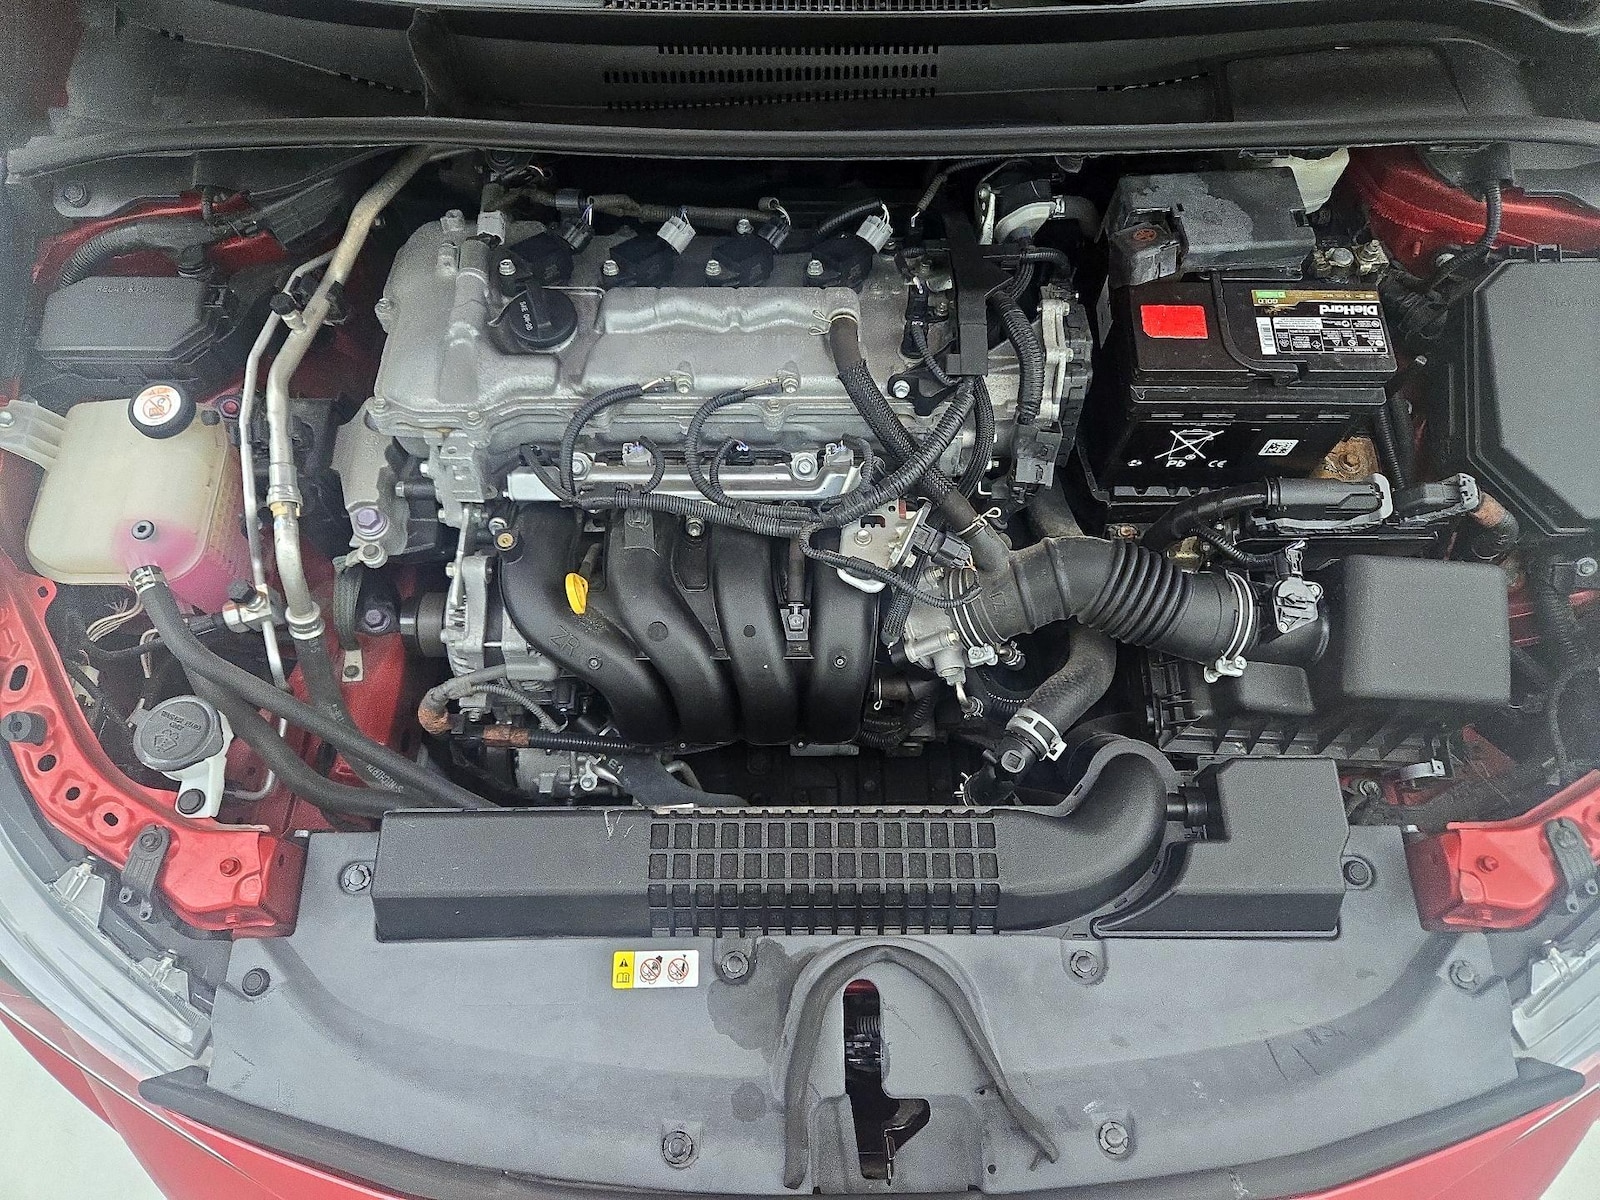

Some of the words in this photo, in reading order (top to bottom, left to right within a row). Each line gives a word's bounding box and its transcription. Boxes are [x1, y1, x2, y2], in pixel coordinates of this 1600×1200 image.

[1319, 304, 1379, 315] DieHard
[1165, 460, 1187, 468] Pb
[550, 624, 580, 657] ZR
